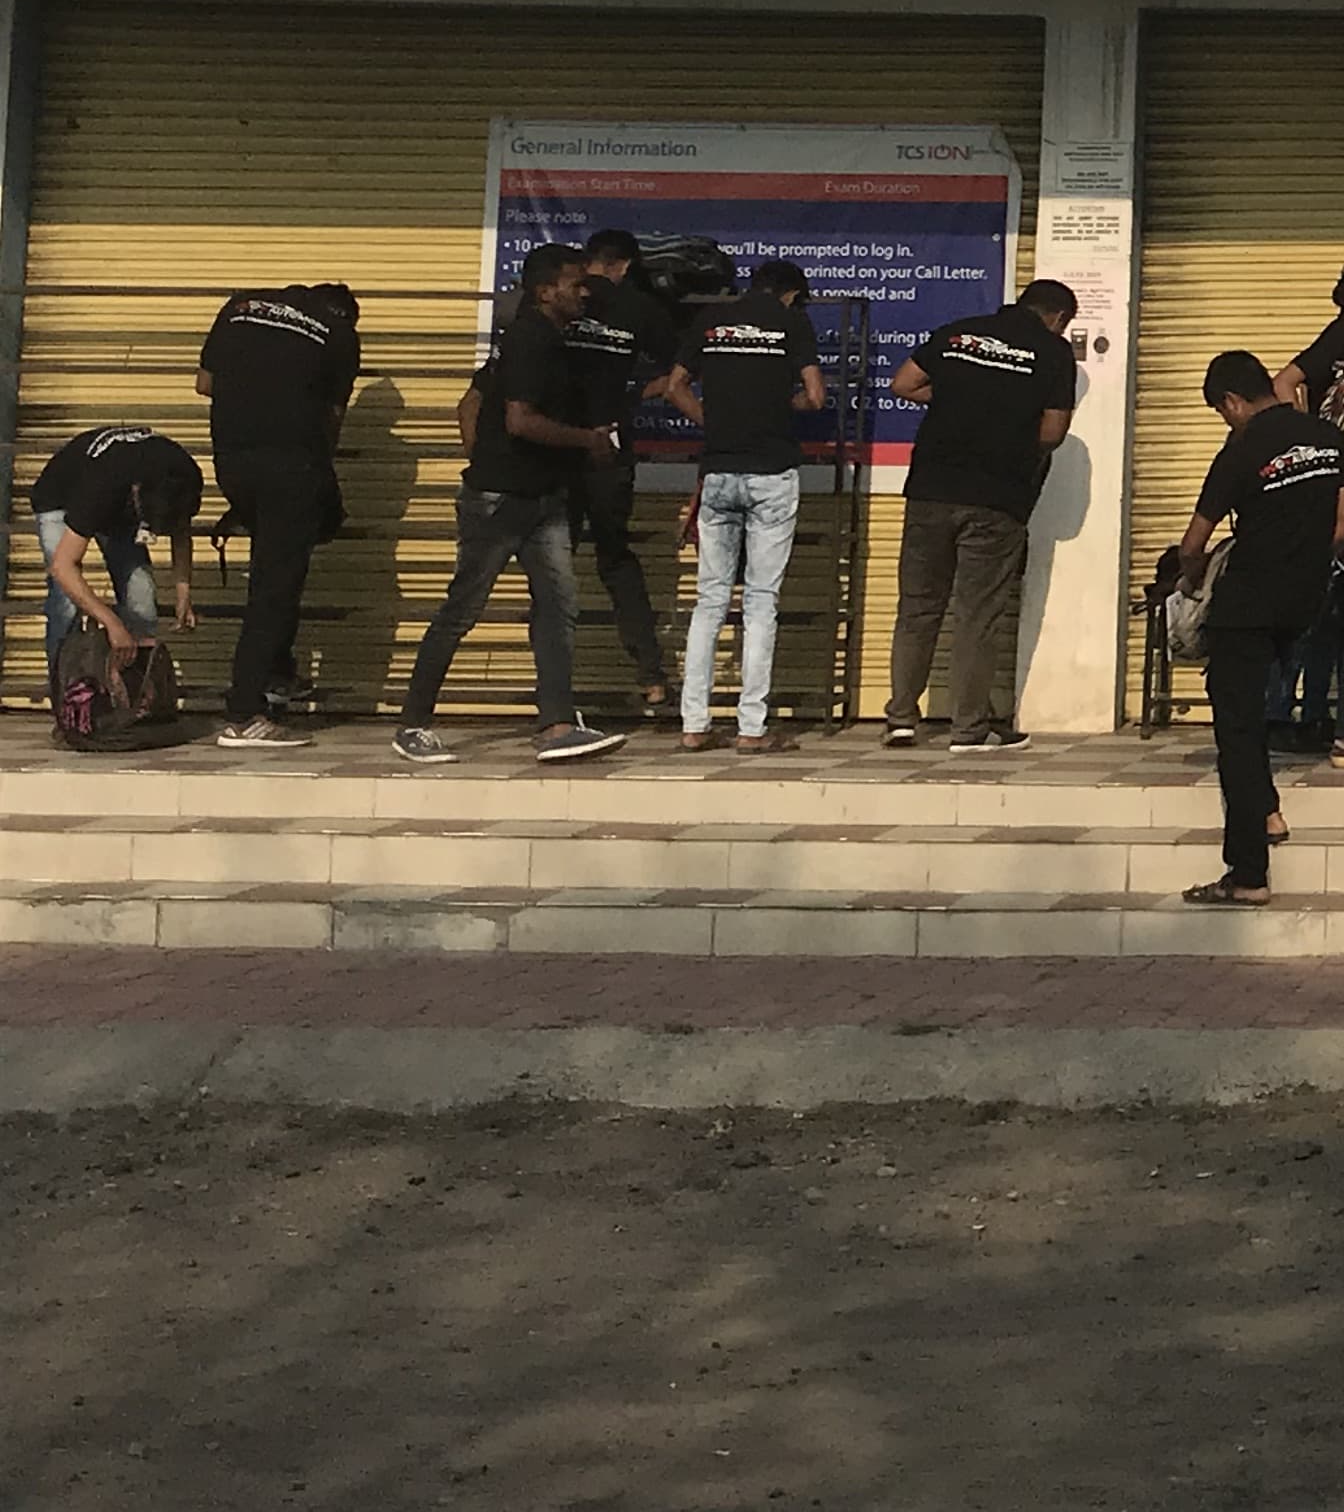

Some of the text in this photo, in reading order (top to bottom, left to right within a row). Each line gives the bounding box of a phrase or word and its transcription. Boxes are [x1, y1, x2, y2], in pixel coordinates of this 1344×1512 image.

[511, 137, 698, 157] General Information
[896, 144, 924, 160] TCS
[824, 180, 921, 194] Exam Duration
[505, 207, 587, 224] Please note
[513, 239, 531, 252] 10
[758, 242, 777, 257] be
[779, 242, 849, 260] prompted
[852, 244, 868, 257] to
[871, 243, 893, 261] log
[896, 244, 914, 258] in.
[858, 267, 877, 279] on
[879, 267, 912, 281] your
[915, 265, 941, 280] Call
[944, 265, 988, 281] Letter.
[888, 286, 916, 301] and
[869, 328, 916, 348] during
[878, 396, 894, 411] to
